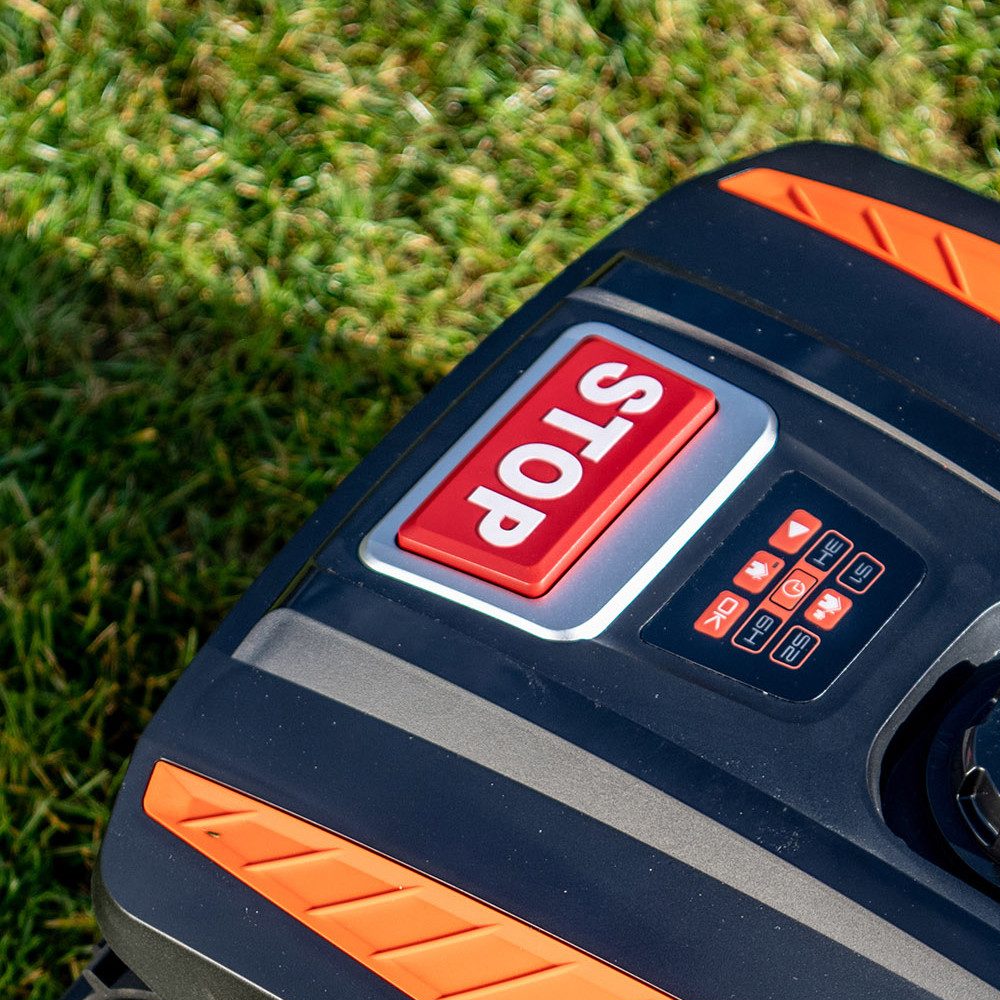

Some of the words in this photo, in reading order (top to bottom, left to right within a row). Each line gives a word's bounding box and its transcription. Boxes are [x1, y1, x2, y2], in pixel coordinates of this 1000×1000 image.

[467, 362, 664, 547] STOP
[813, 537, 844, 566] 3H
[849, 562, 874, 584] S1
[703, 597, 739, 631] OK
[743, 613, 775, 645] 6H
[780, 632, 811, 662] S2
